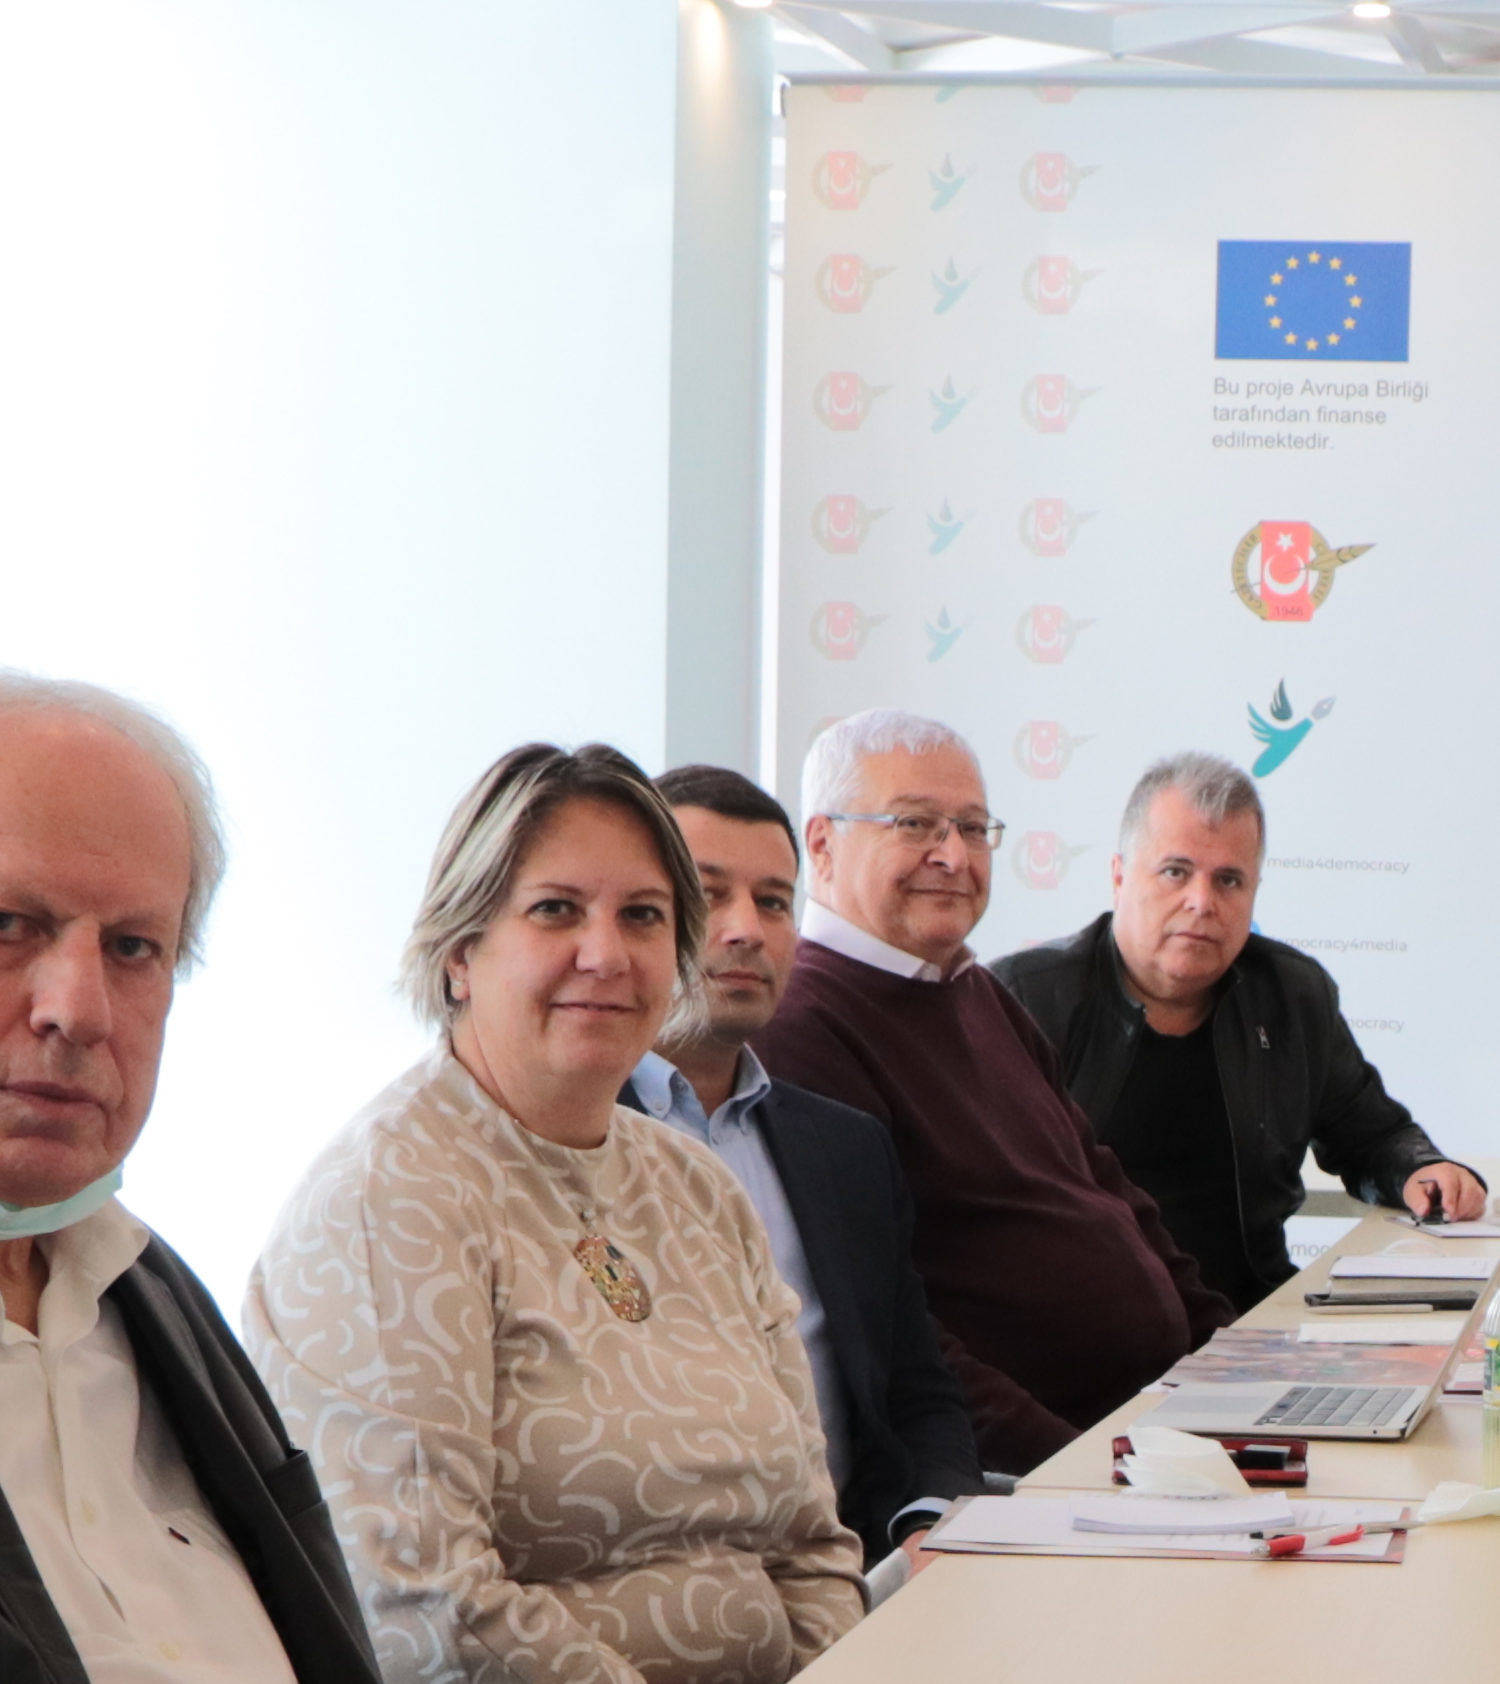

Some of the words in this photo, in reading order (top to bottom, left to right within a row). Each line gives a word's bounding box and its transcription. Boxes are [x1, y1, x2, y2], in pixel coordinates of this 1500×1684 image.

[1214, 377, 1239, 396] Bu
[1246, 378, 1294, 401] proje
[1300, 379, 1369, 400] Avrupa
[1375, 380, 1430, 403] Birliği
[1213, 404, 1310, 423] tarafından
[1317, 405, 1387, 425] finanse
[1212, 431, 1335, 450] edilmektedir.
[1267, 856, 1410, 875] media4democracy
